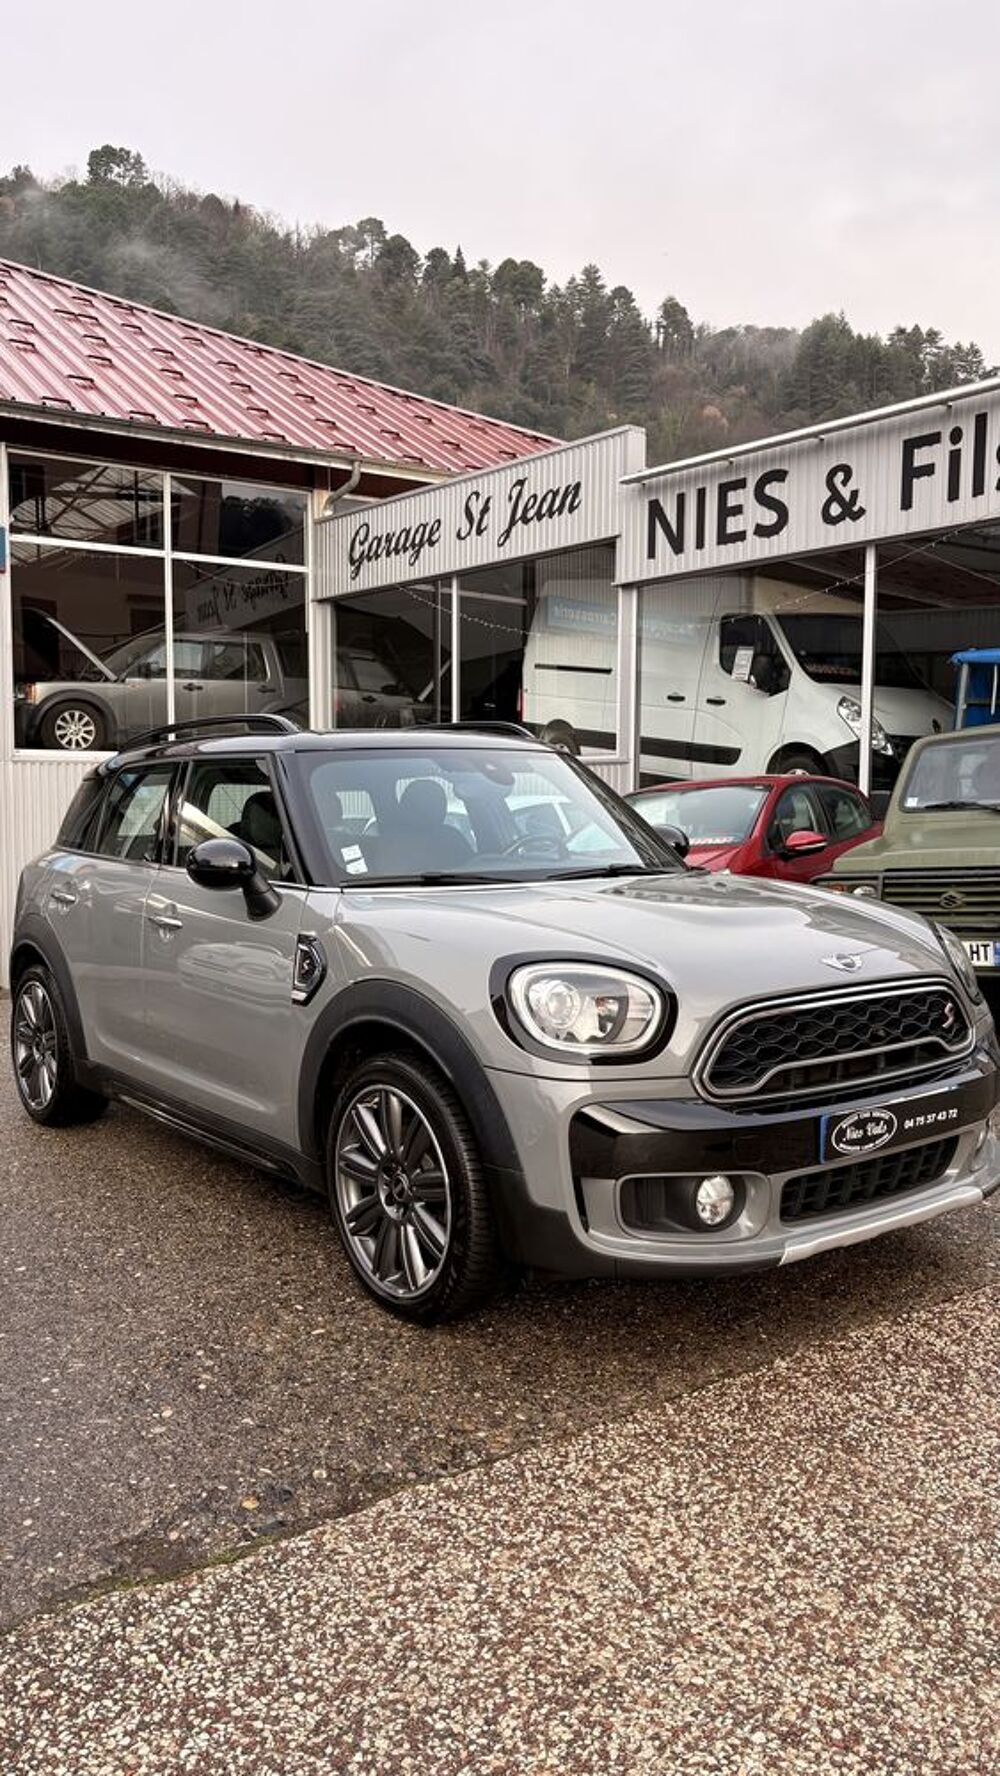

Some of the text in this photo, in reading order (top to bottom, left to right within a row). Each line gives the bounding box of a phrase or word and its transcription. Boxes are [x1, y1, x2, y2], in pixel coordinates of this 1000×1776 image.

[349, 477, 582, 580] Garage St Jean
[648, 469, 789, 559] NIES
[821, 463, 866, 526] &
[904, 1118, 914, 1130] 04
[916, 1115, 925, 1126] 75
[937, 1111, 947, 1120] 43
